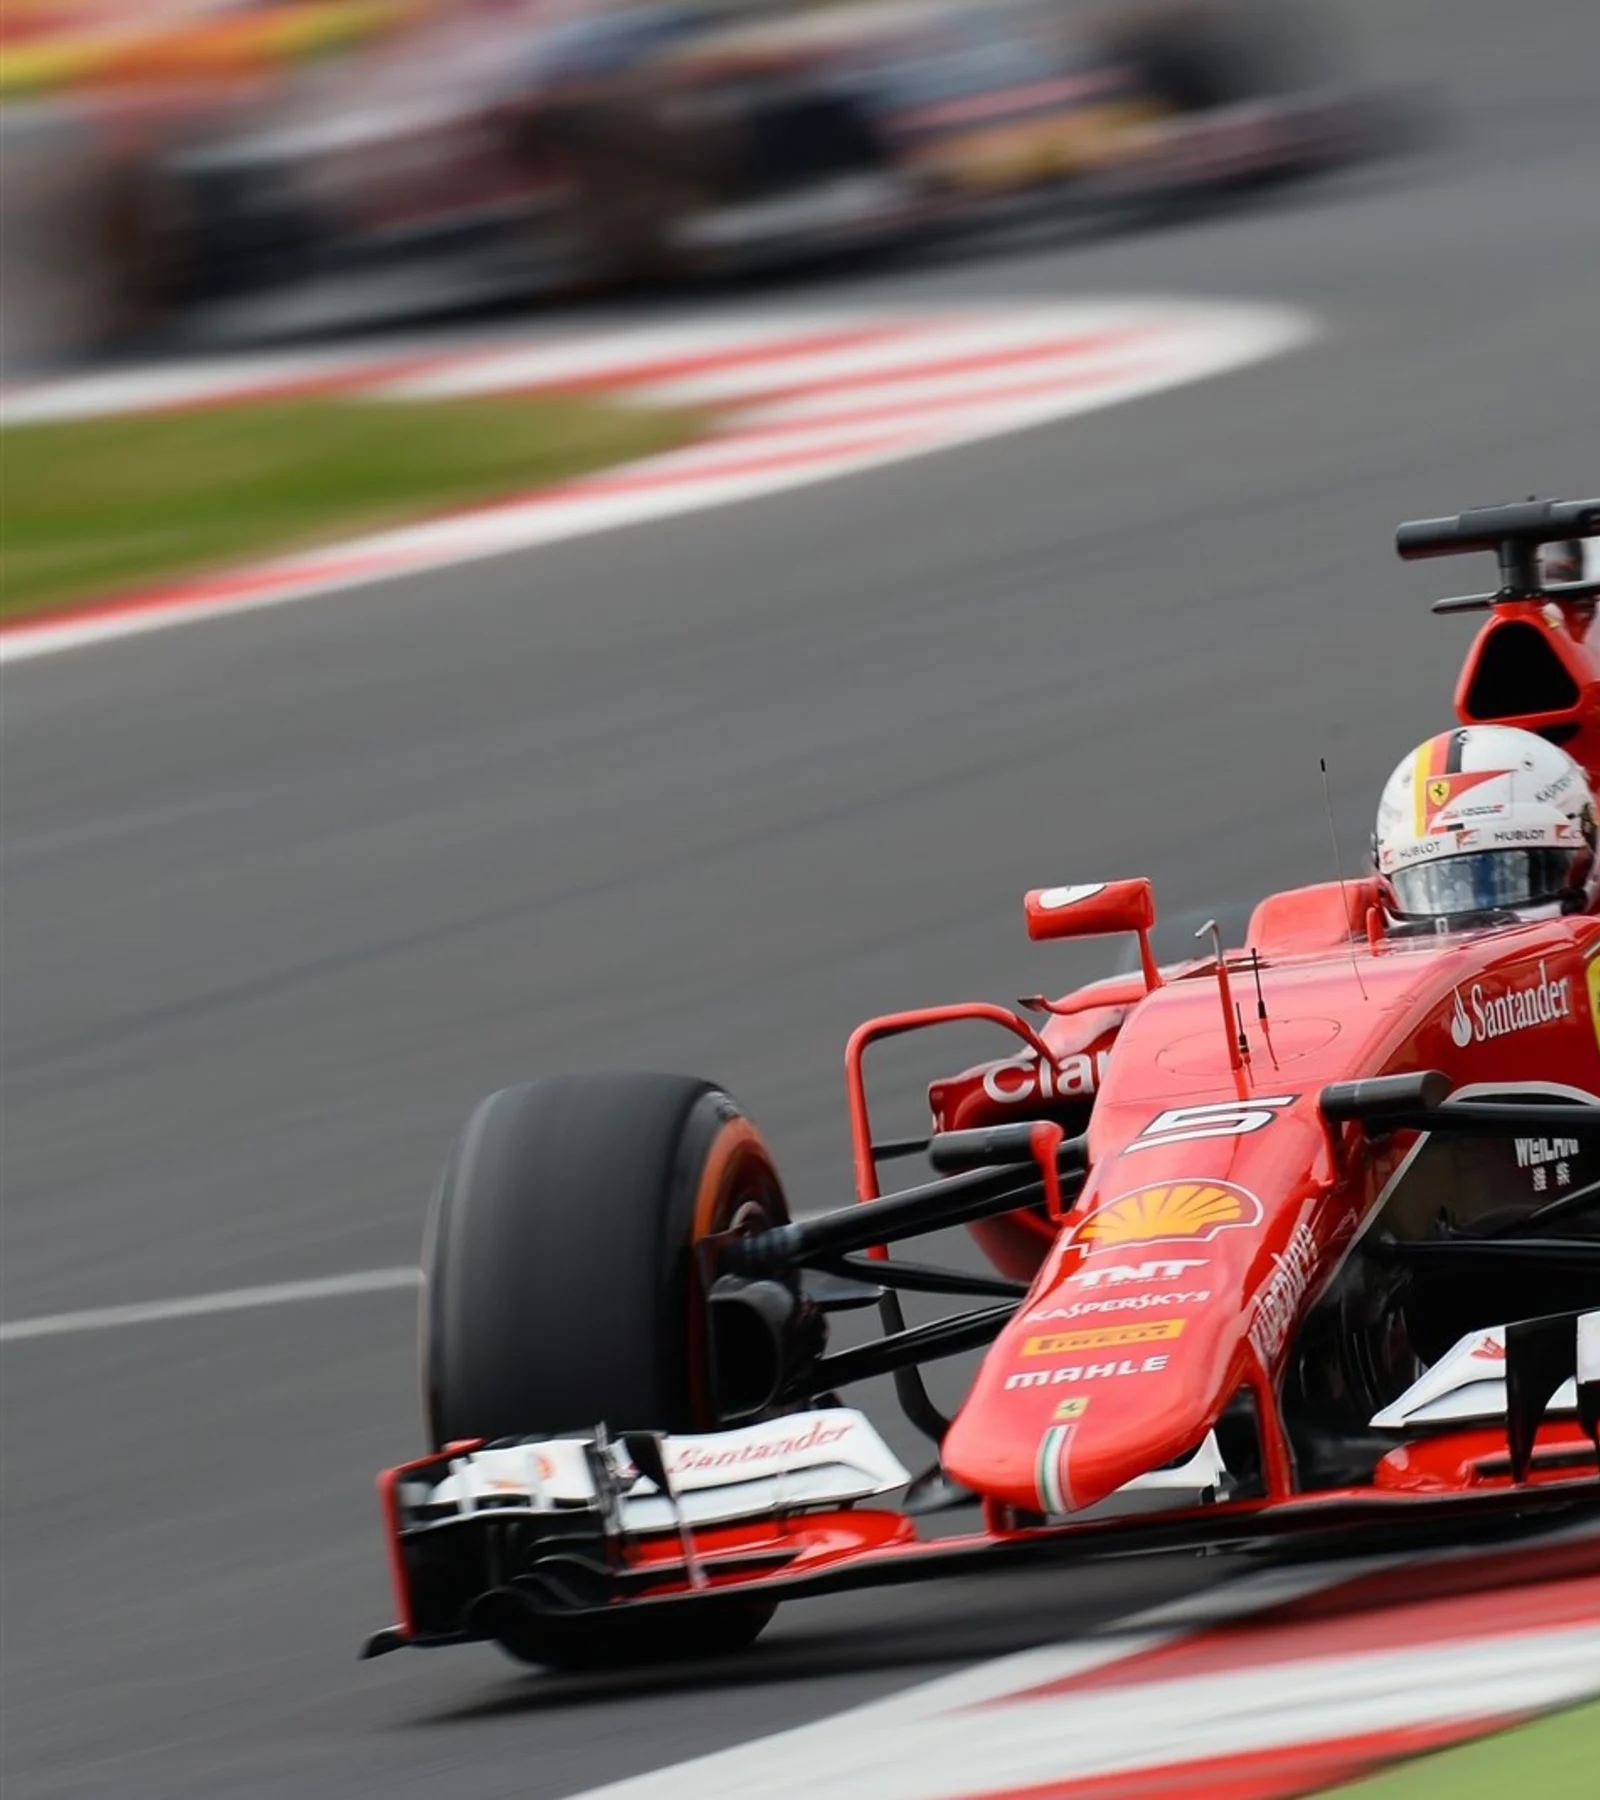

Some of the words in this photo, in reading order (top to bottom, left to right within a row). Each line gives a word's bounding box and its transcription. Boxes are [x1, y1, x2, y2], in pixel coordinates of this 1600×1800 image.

[1494, 829, 1546, 842] HUBLOT
[1472, 960, 1571, 1042] Santander
[1122, 1094, 1300, 1156] 5
[1065, 1259, 1210, 1288] TNT
[1004, 1355, 1170, 1390] MAHLE
[667, 1417, 856, 1474] Santander
